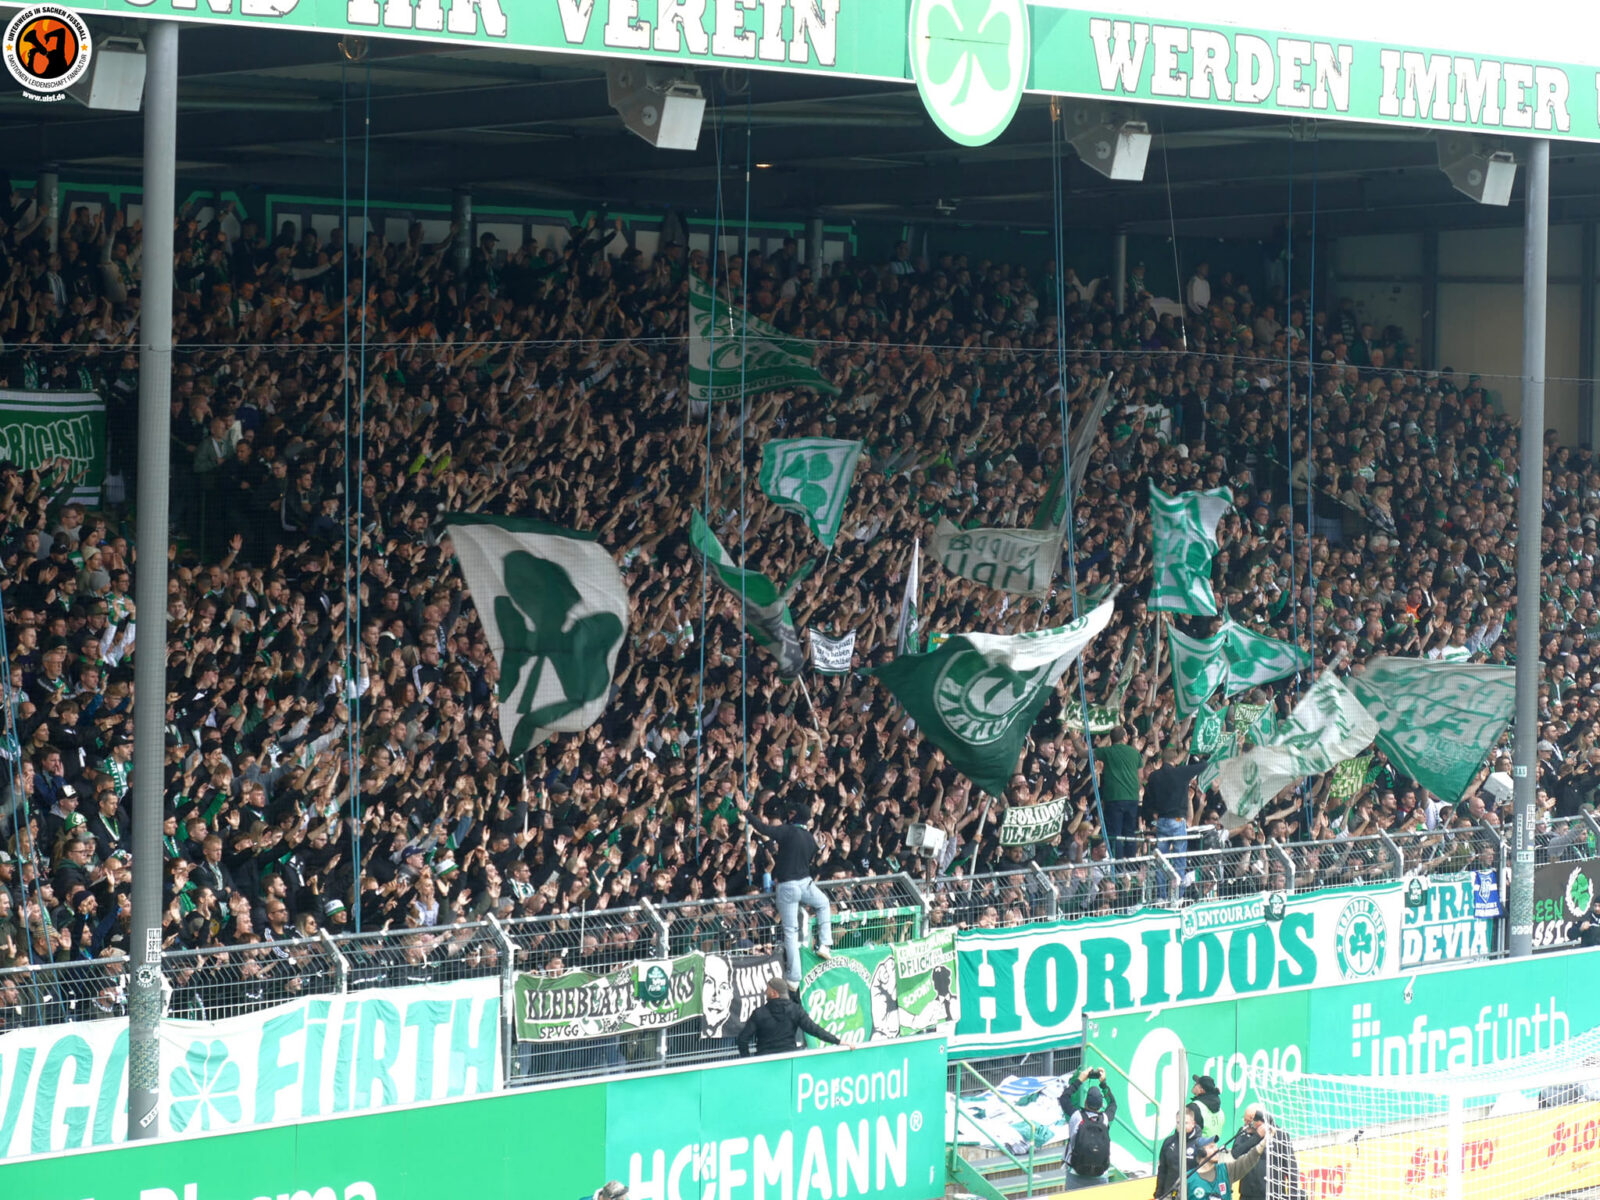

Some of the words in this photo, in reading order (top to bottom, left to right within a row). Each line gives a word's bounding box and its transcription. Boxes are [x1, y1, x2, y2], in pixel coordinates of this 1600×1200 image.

[557, 0, 838, 66] VEREIN
[1089, 18, 1353, 111] WERDEN
[1378, 48, 1571, 132] IMMER
[1004, 799, 1067, 826] HORIDOS
[1402, 921, 1490, 965] DEVIA
[525, 981, 638, 1021] KLEEBLATT
[957, 912, 1317, 1034] HORIDOS
[539, 1024, 580, 1040] SPVGG
[639, 1008, 680, 1027] FÜRTH
[1371, 997, 1570, 1077] infrafürth
[254, 996, 500, 1124] FÜRTH
[797, 1057, 909, 1113] Personal
[1572, 1118, 1600, 1154] LO
